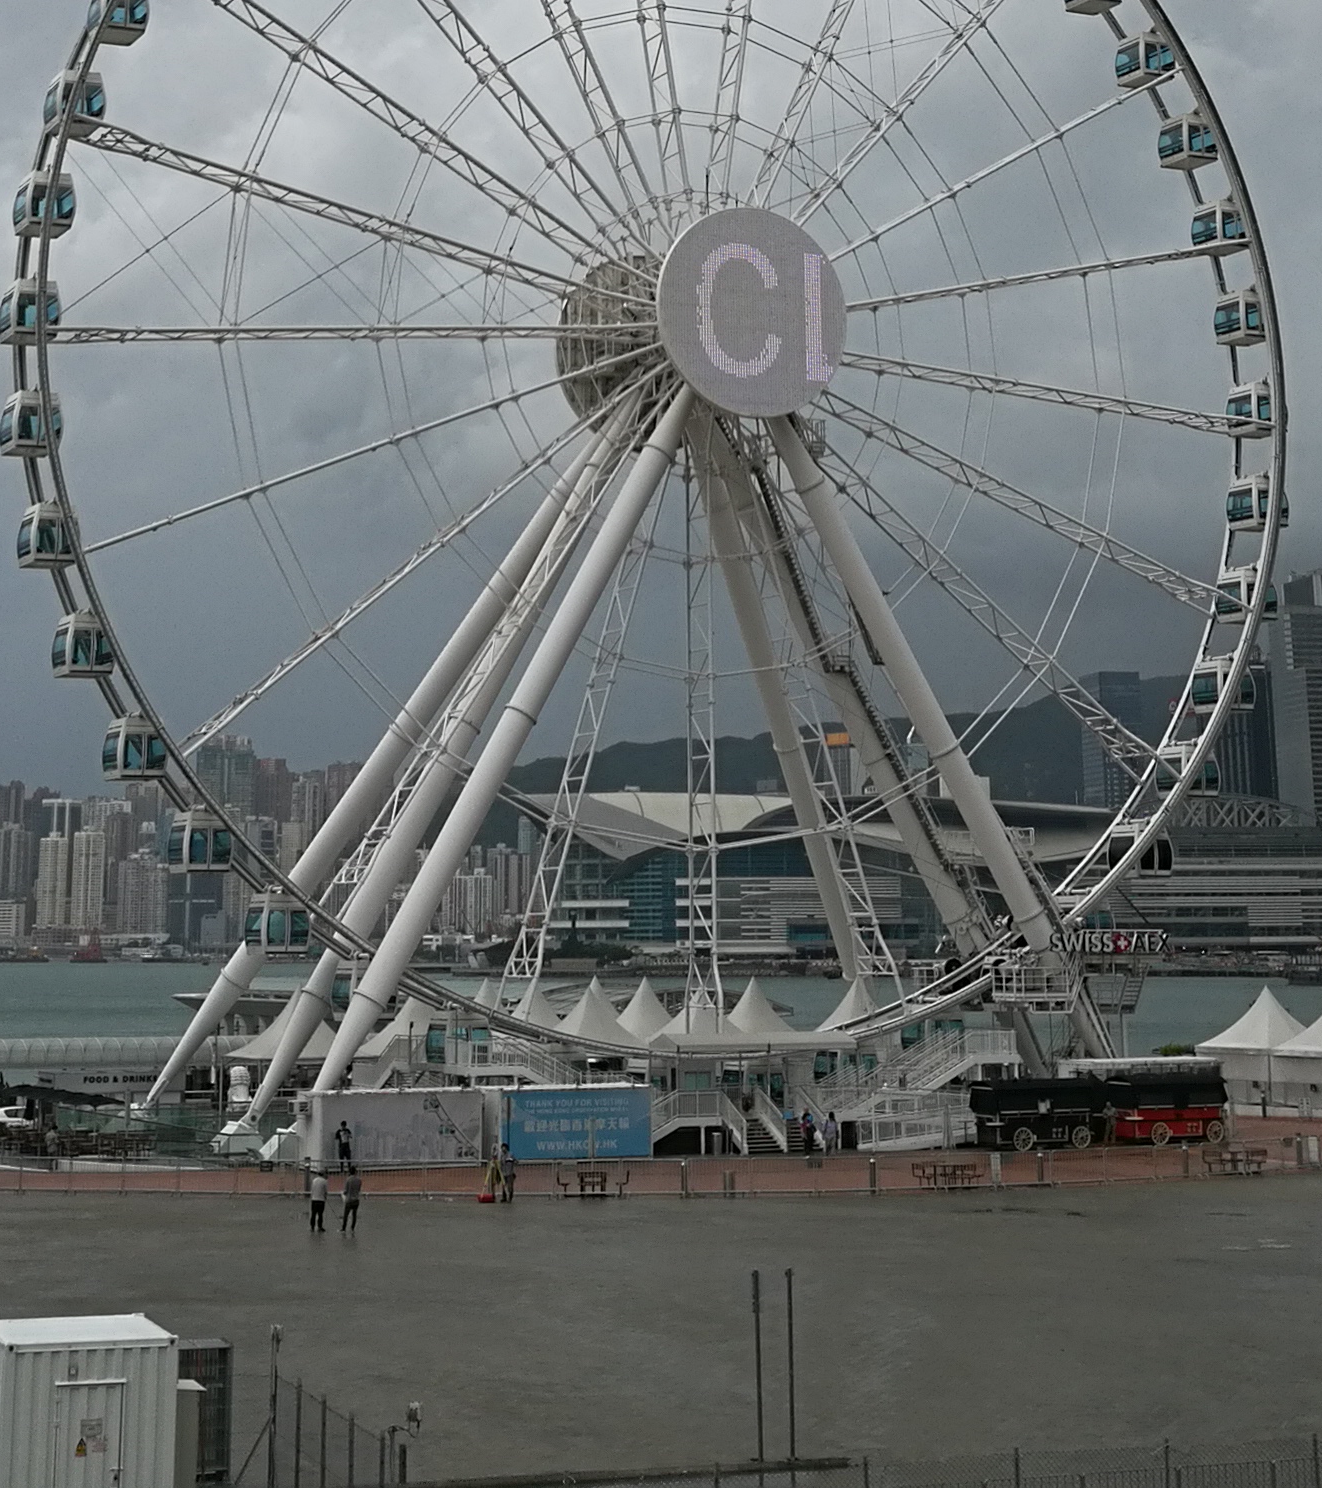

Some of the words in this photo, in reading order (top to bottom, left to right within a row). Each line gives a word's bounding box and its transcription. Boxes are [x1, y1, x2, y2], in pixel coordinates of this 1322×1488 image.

[1051, 932, 1115, 953] SWISS
[122, 1075, 159, 1083] DRINKS
[525, 1099, 553, 1108] THANK
[555, 1098, 573, 1107] YOU
[575, 1098, 593, 1107] FOR
[594, 1097, 629, 1106] VISITING
